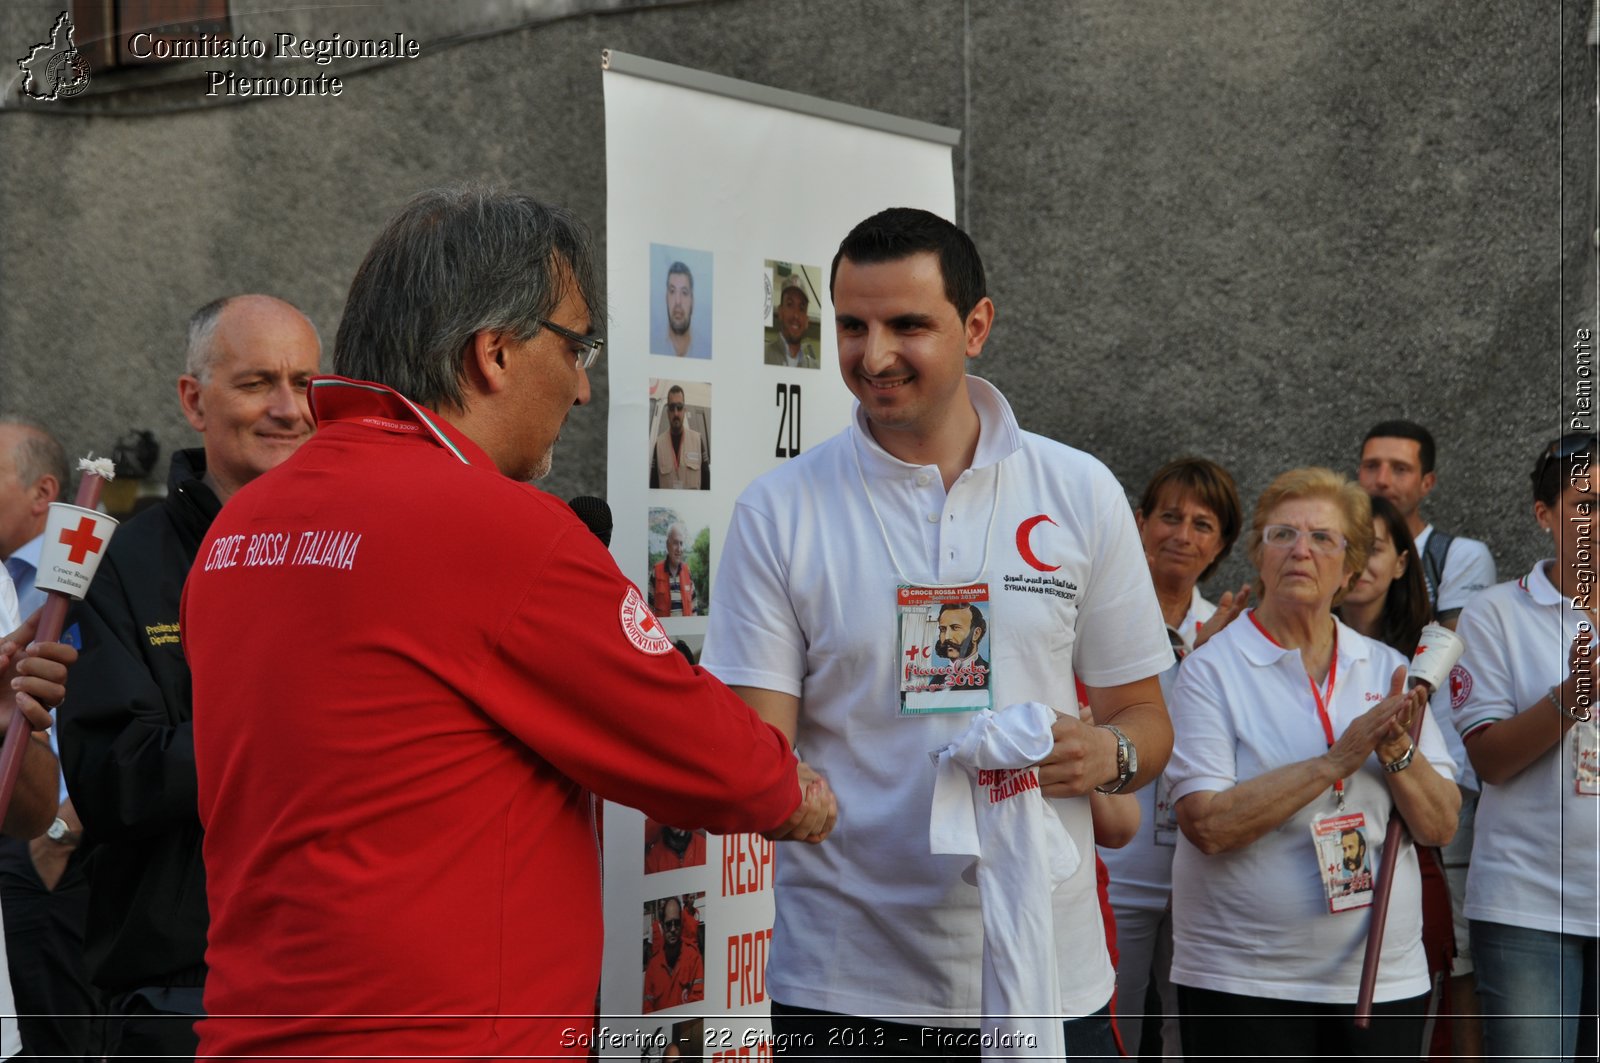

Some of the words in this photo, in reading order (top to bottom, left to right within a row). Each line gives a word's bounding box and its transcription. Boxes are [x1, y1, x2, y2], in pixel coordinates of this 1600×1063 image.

[775, 383, 801, 458] 20
[204, 534, 246, 572] CROCE
[243, 532, 291, 567] ROSSA
[291, 530, 362, 571] ITALIANA
[53, 566, 73, 576] Croce
[1004, 584, 1027, 592] SYRIAN
[1028, 586, 1044, 594] ARAB
[624, 606, 633, 616] DI
[623, 617, 669, 652] CONVENZIONE
[905, 660, 989, 681] fiaccolata
[945, 674, 985, 687] 2013
[989, 770, 1039, 804] ITALIANA
[722, 832, 775, 897] RESP
